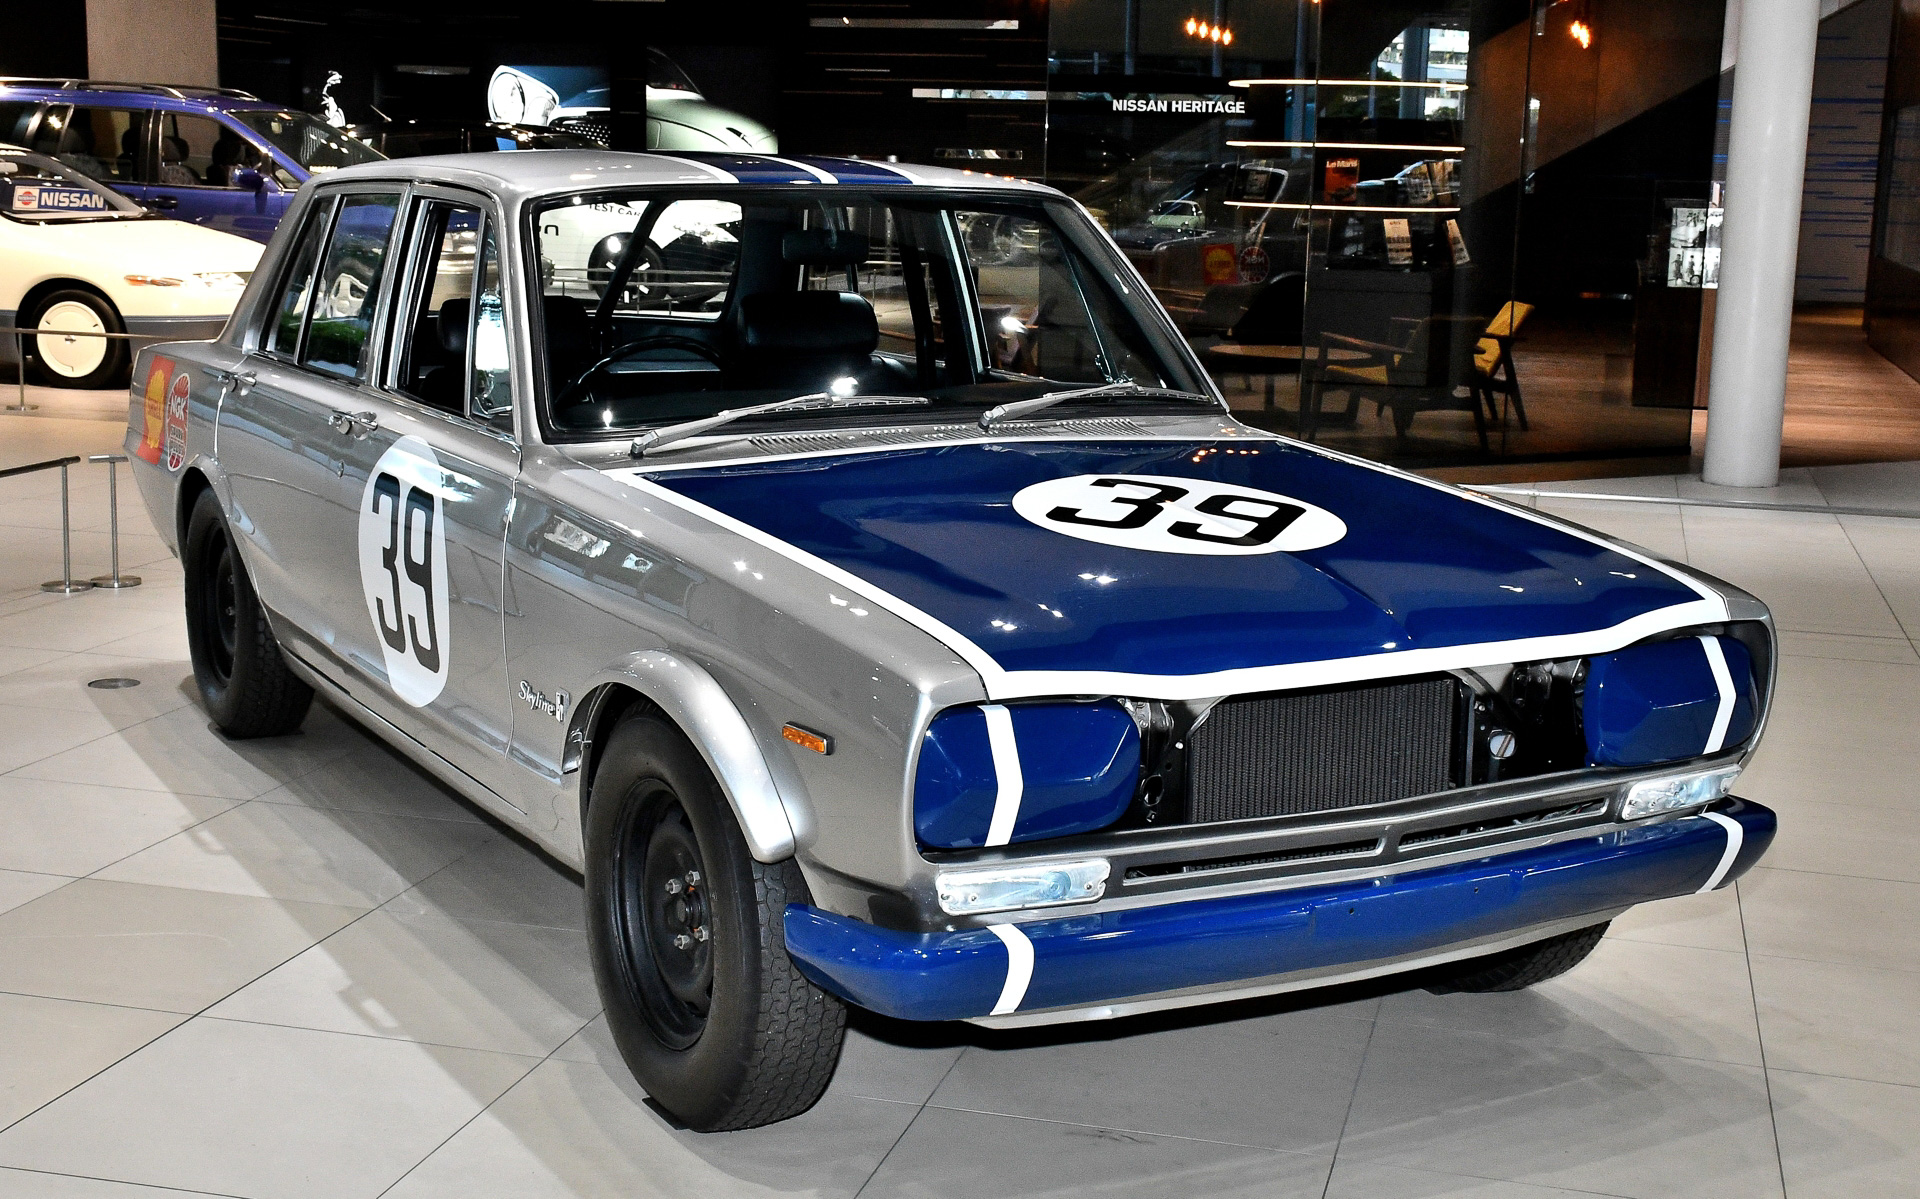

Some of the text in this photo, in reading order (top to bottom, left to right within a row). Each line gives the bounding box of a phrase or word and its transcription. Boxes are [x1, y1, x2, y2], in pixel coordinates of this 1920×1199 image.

[1112, 99, 1246, 114] NISSAN HERITAGE
[40, 191, 104, 209] NISSAN
[588, 203, 615, 214] TEST
[170, 395, 186, 420] NGK
[1045, 479, 1307, 547] 39
[372, 472, 440, 674] 39
[518, 680, 556, 716] Skyline
